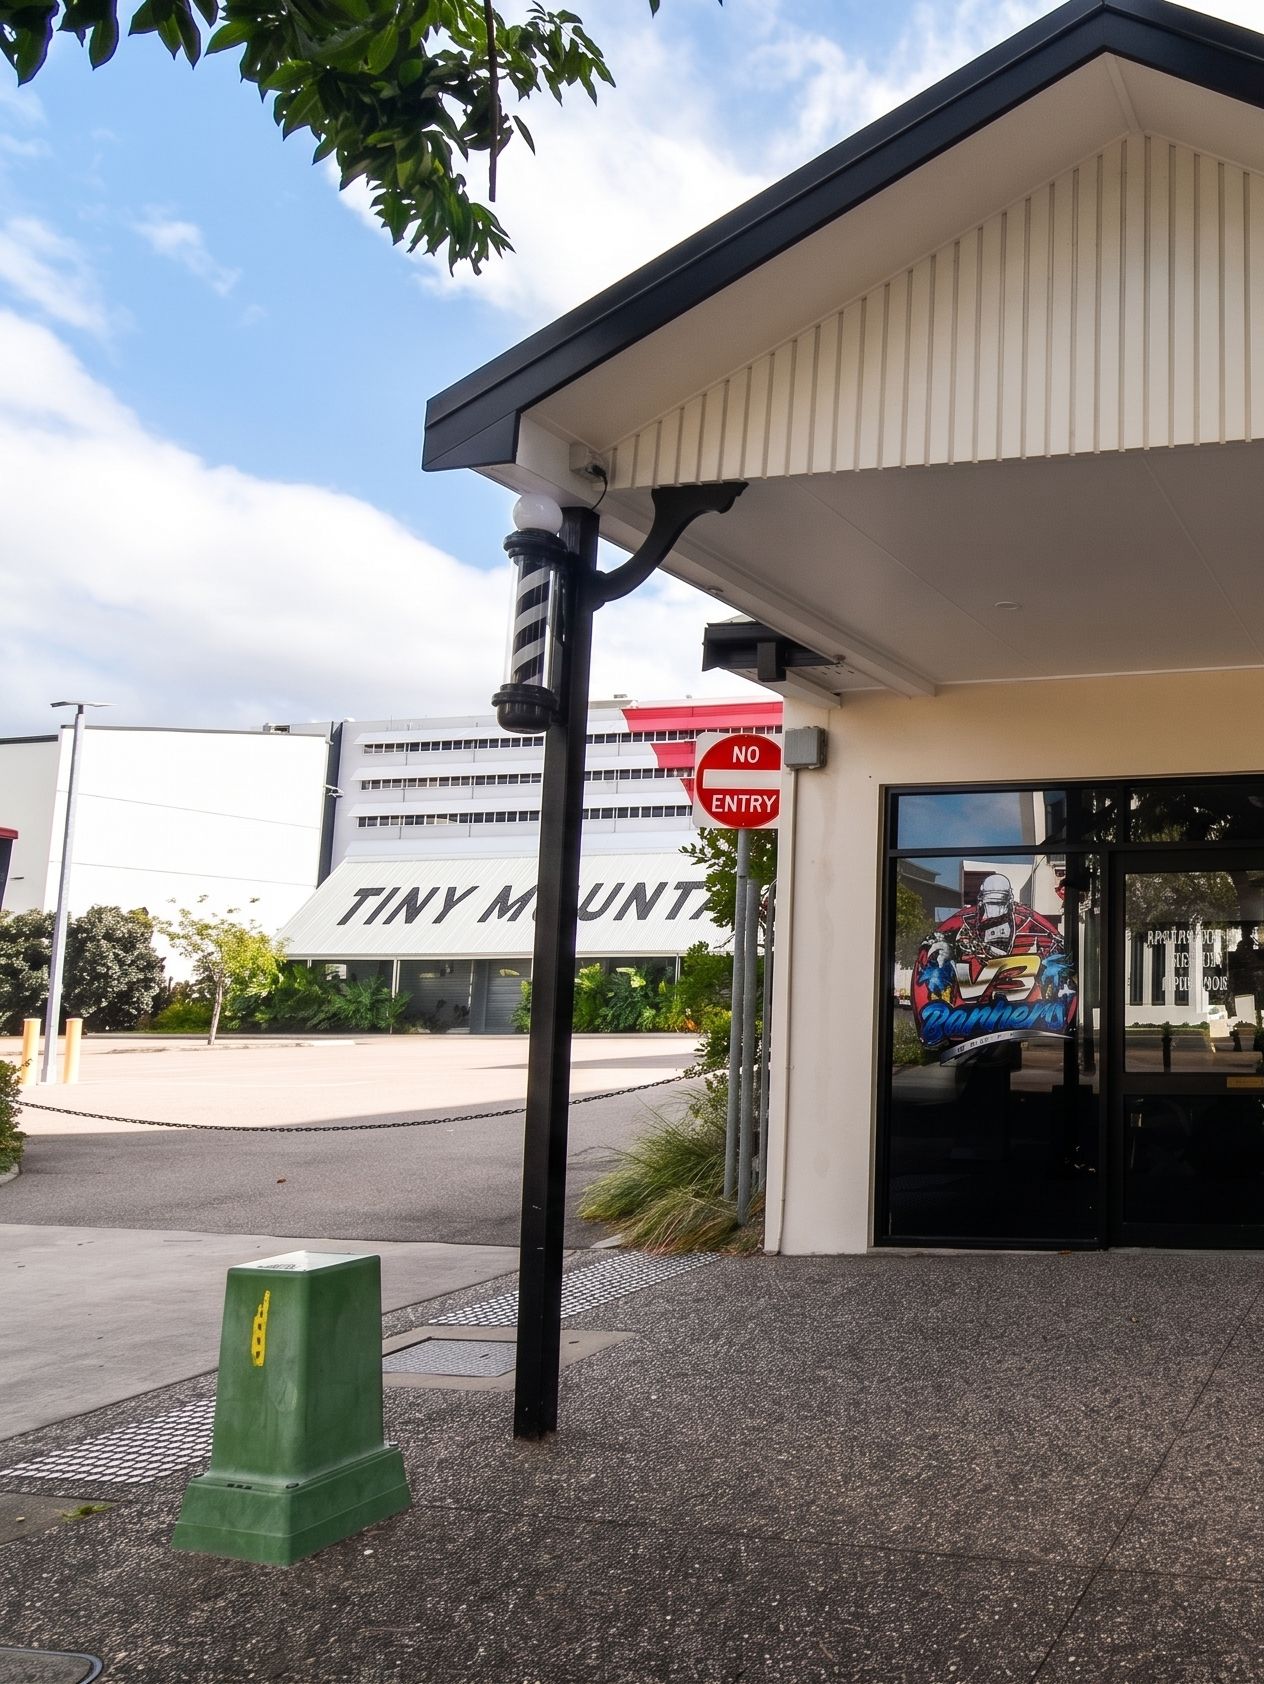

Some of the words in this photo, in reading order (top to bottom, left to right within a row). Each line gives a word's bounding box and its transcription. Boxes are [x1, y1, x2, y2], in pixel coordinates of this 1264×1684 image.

[732, 745, 760, 763] NO
[711, 794, 777, 813] ENTRY
[336, 885, 480, 926] TINY
[477, 881, 713, 923] MUNT
[954, 953, 1042, 1002] V3
